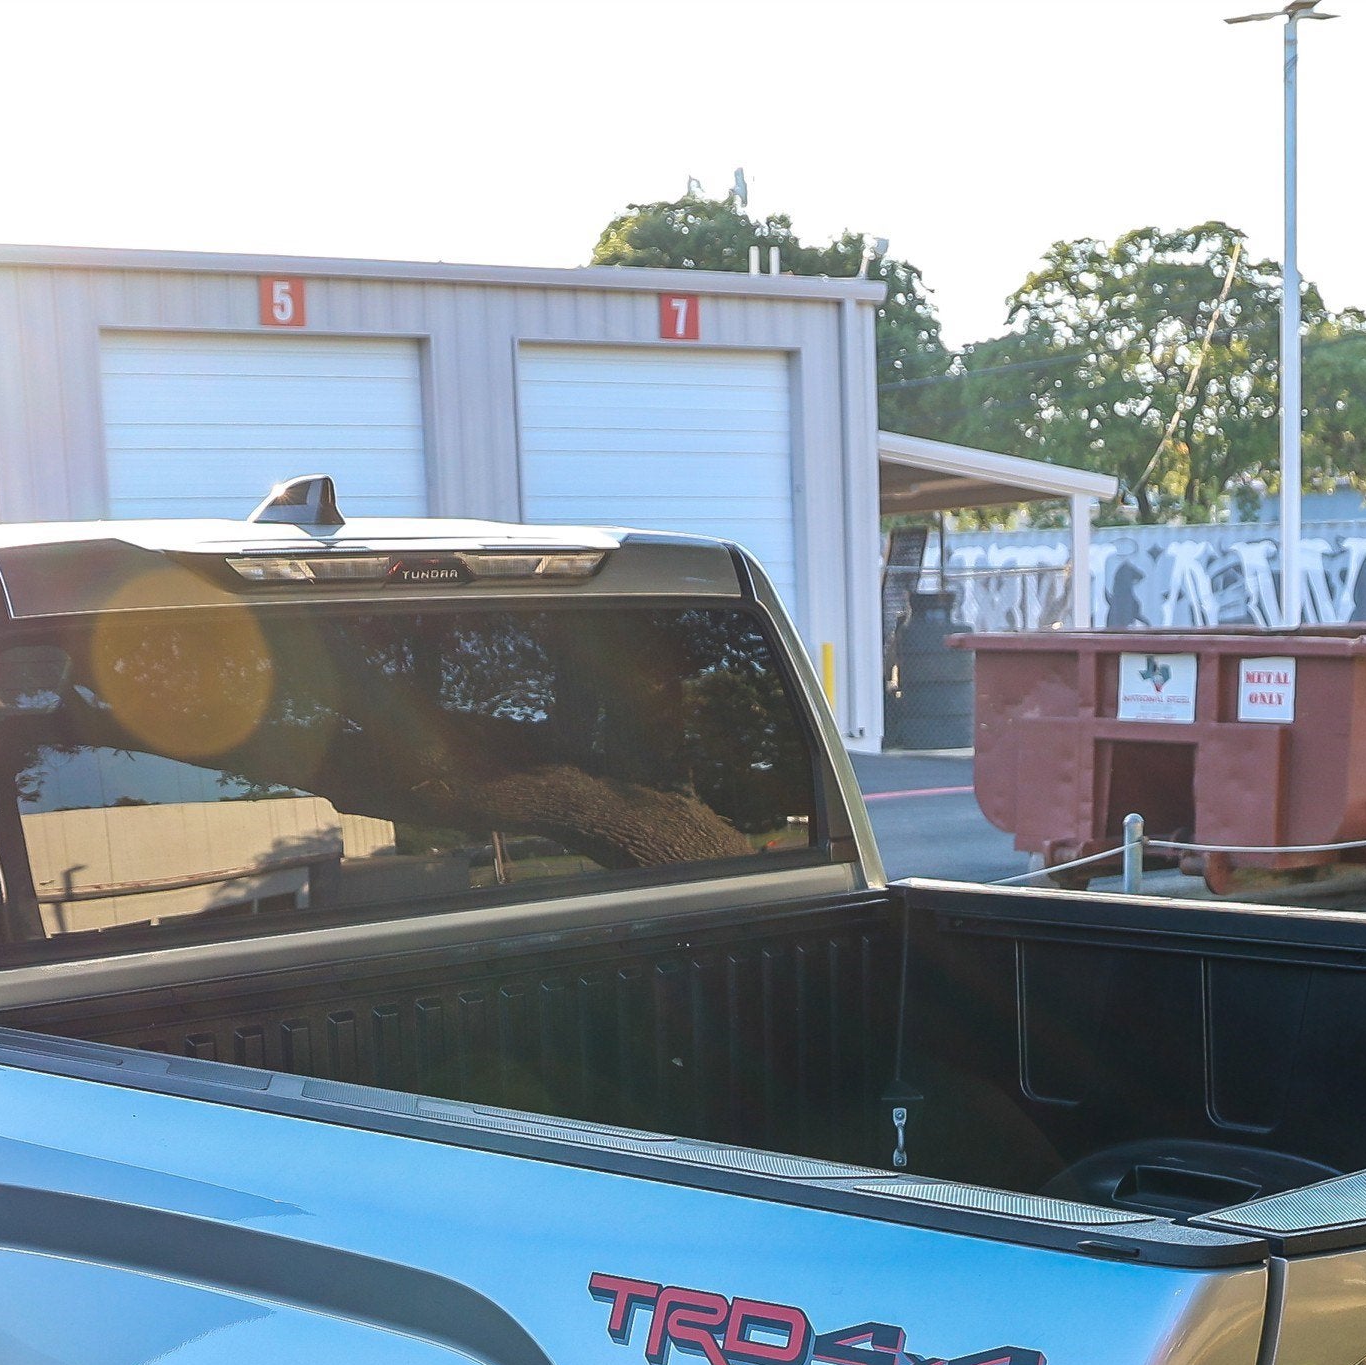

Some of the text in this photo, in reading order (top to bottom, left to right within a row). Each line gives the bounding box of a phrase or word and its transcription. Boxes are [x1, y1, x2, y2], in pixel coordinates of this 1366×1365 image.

[272, 280, 292, 321] 5
[670, 298, 687, 336] 7
[402, 569, 458, 580] TUNDRA
[1245, 671, 1291, 685] METAL
[1248, 692, 1285, 706] ONLY
